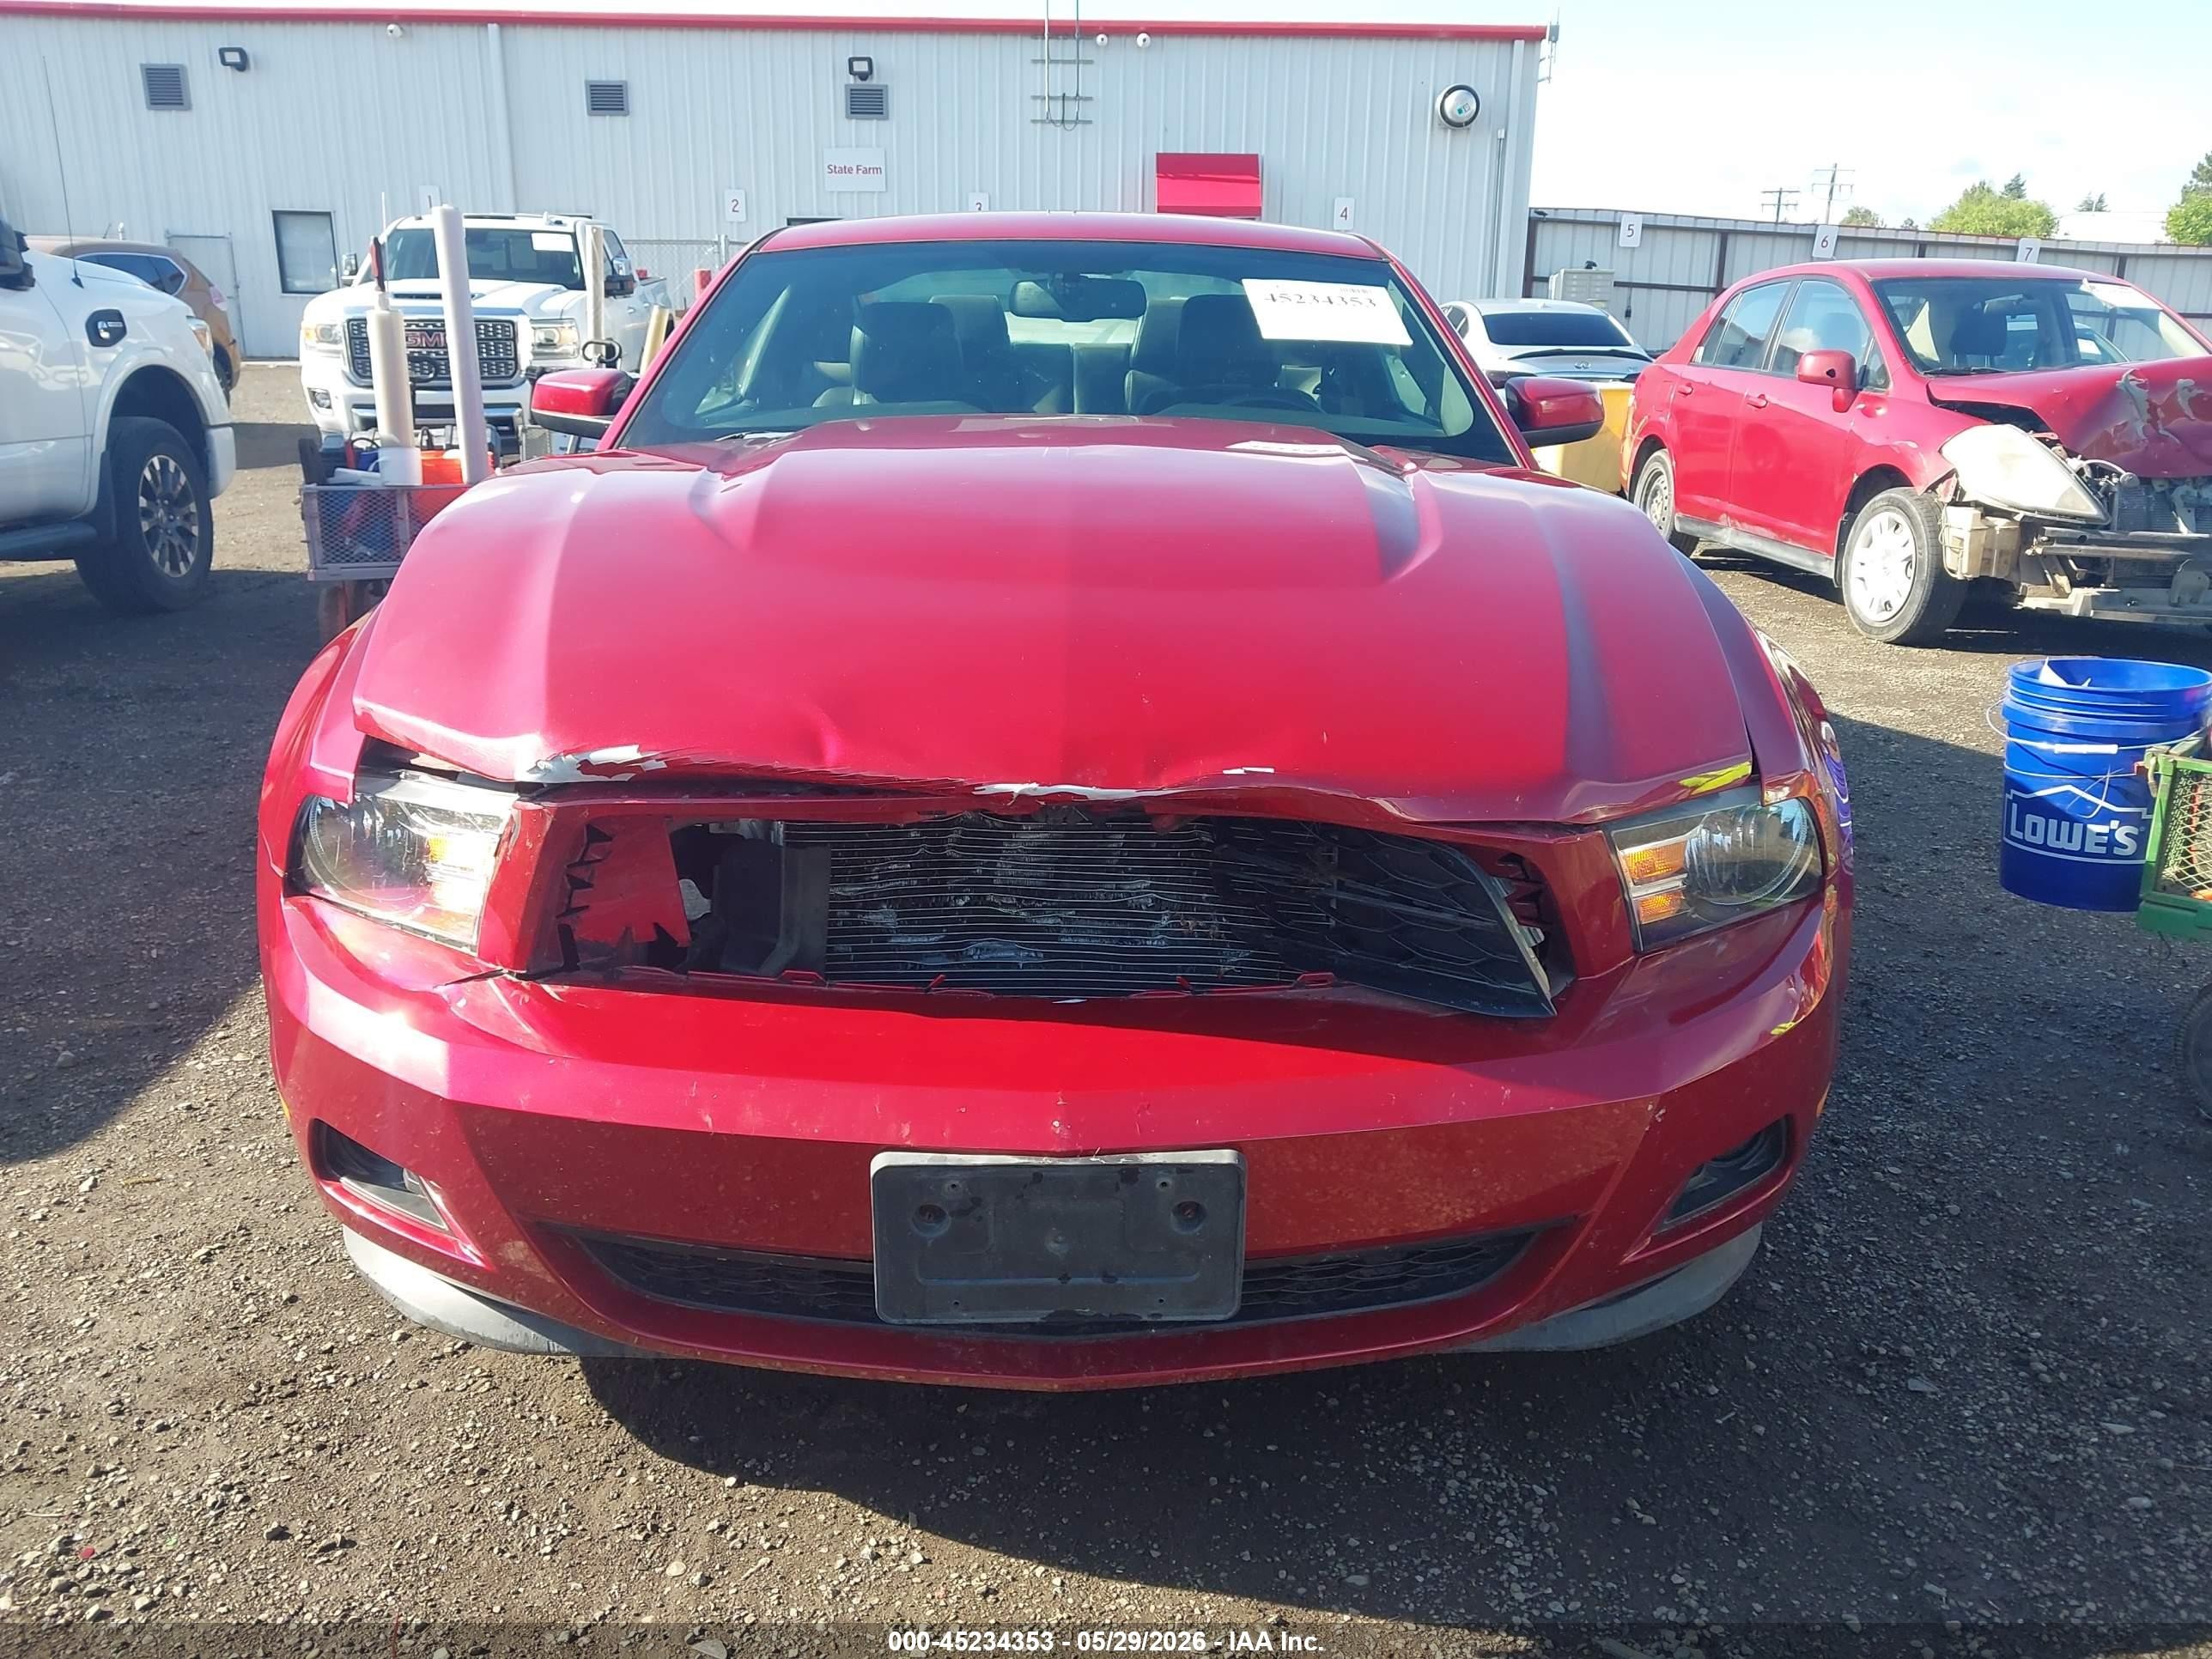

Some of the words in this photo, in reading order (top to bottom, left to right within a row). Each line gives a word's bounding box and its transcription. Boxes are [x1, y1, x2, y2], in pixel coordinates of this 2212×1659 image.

[827, 164, 854, 174] State
[856, 164, 883, 174] Farm
[732, 198, 739, 213] 2
[1340, 206, 1348, 221] 4
[1627, 223, 1635, 238] 5
[1820, 234, 1829, 248] 6
[2025, 246, 2033, 262] 7
[404, 331, 447, 348] GM
[2010, 802, 2139, 856] LOWE'S
